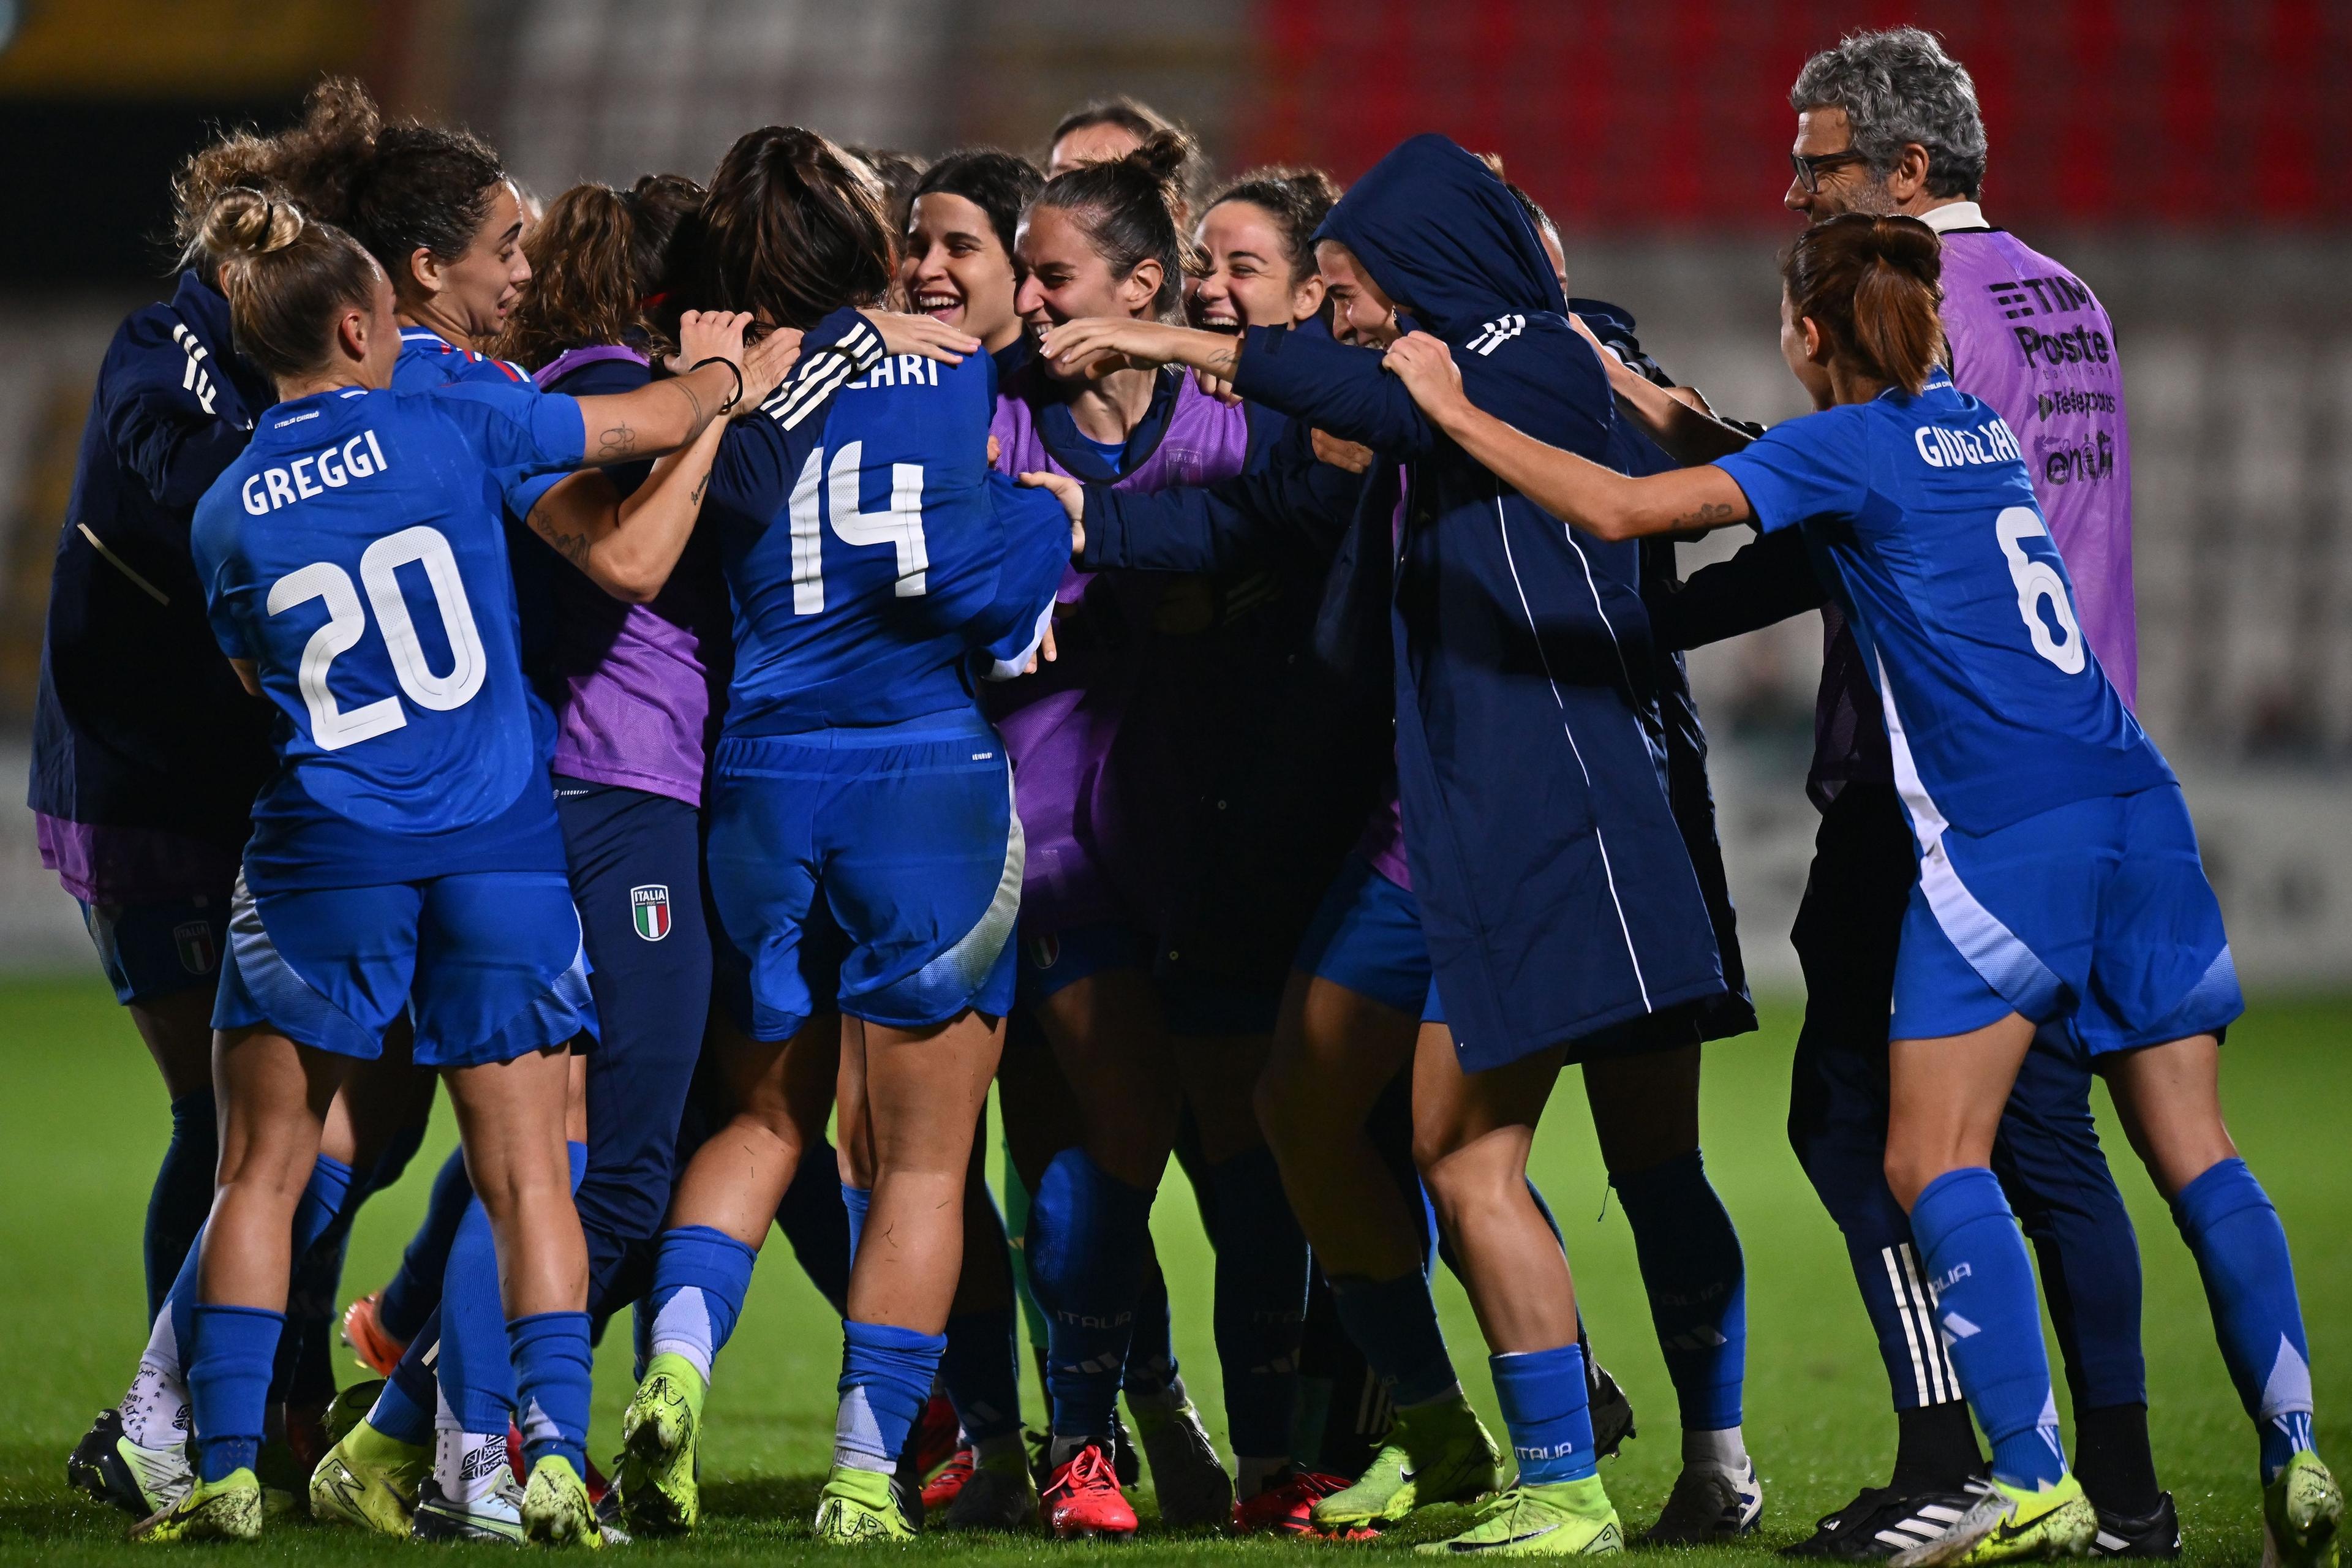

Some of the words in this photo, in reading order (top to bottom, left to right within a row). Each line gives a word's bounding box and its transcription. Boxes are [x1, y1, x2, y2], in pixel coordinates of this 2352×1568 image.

[2015, 325, 2109, 369] Poste
[845, 354, 938, 390] ARI
[243, 430, 387, 515] GREGGI
[789, 440, 929, 615] 14
[1996, 507, 2086, 674] 6
[266, 526, 486, 751] 20
[634, 889, 665, 902] ITALIA
[1932, 1262, 1972, 1294] ALIA
[1057, 1309, 1132, 1329] ITALIA
[1515, 1441, 1572, 1460] ITALIA
